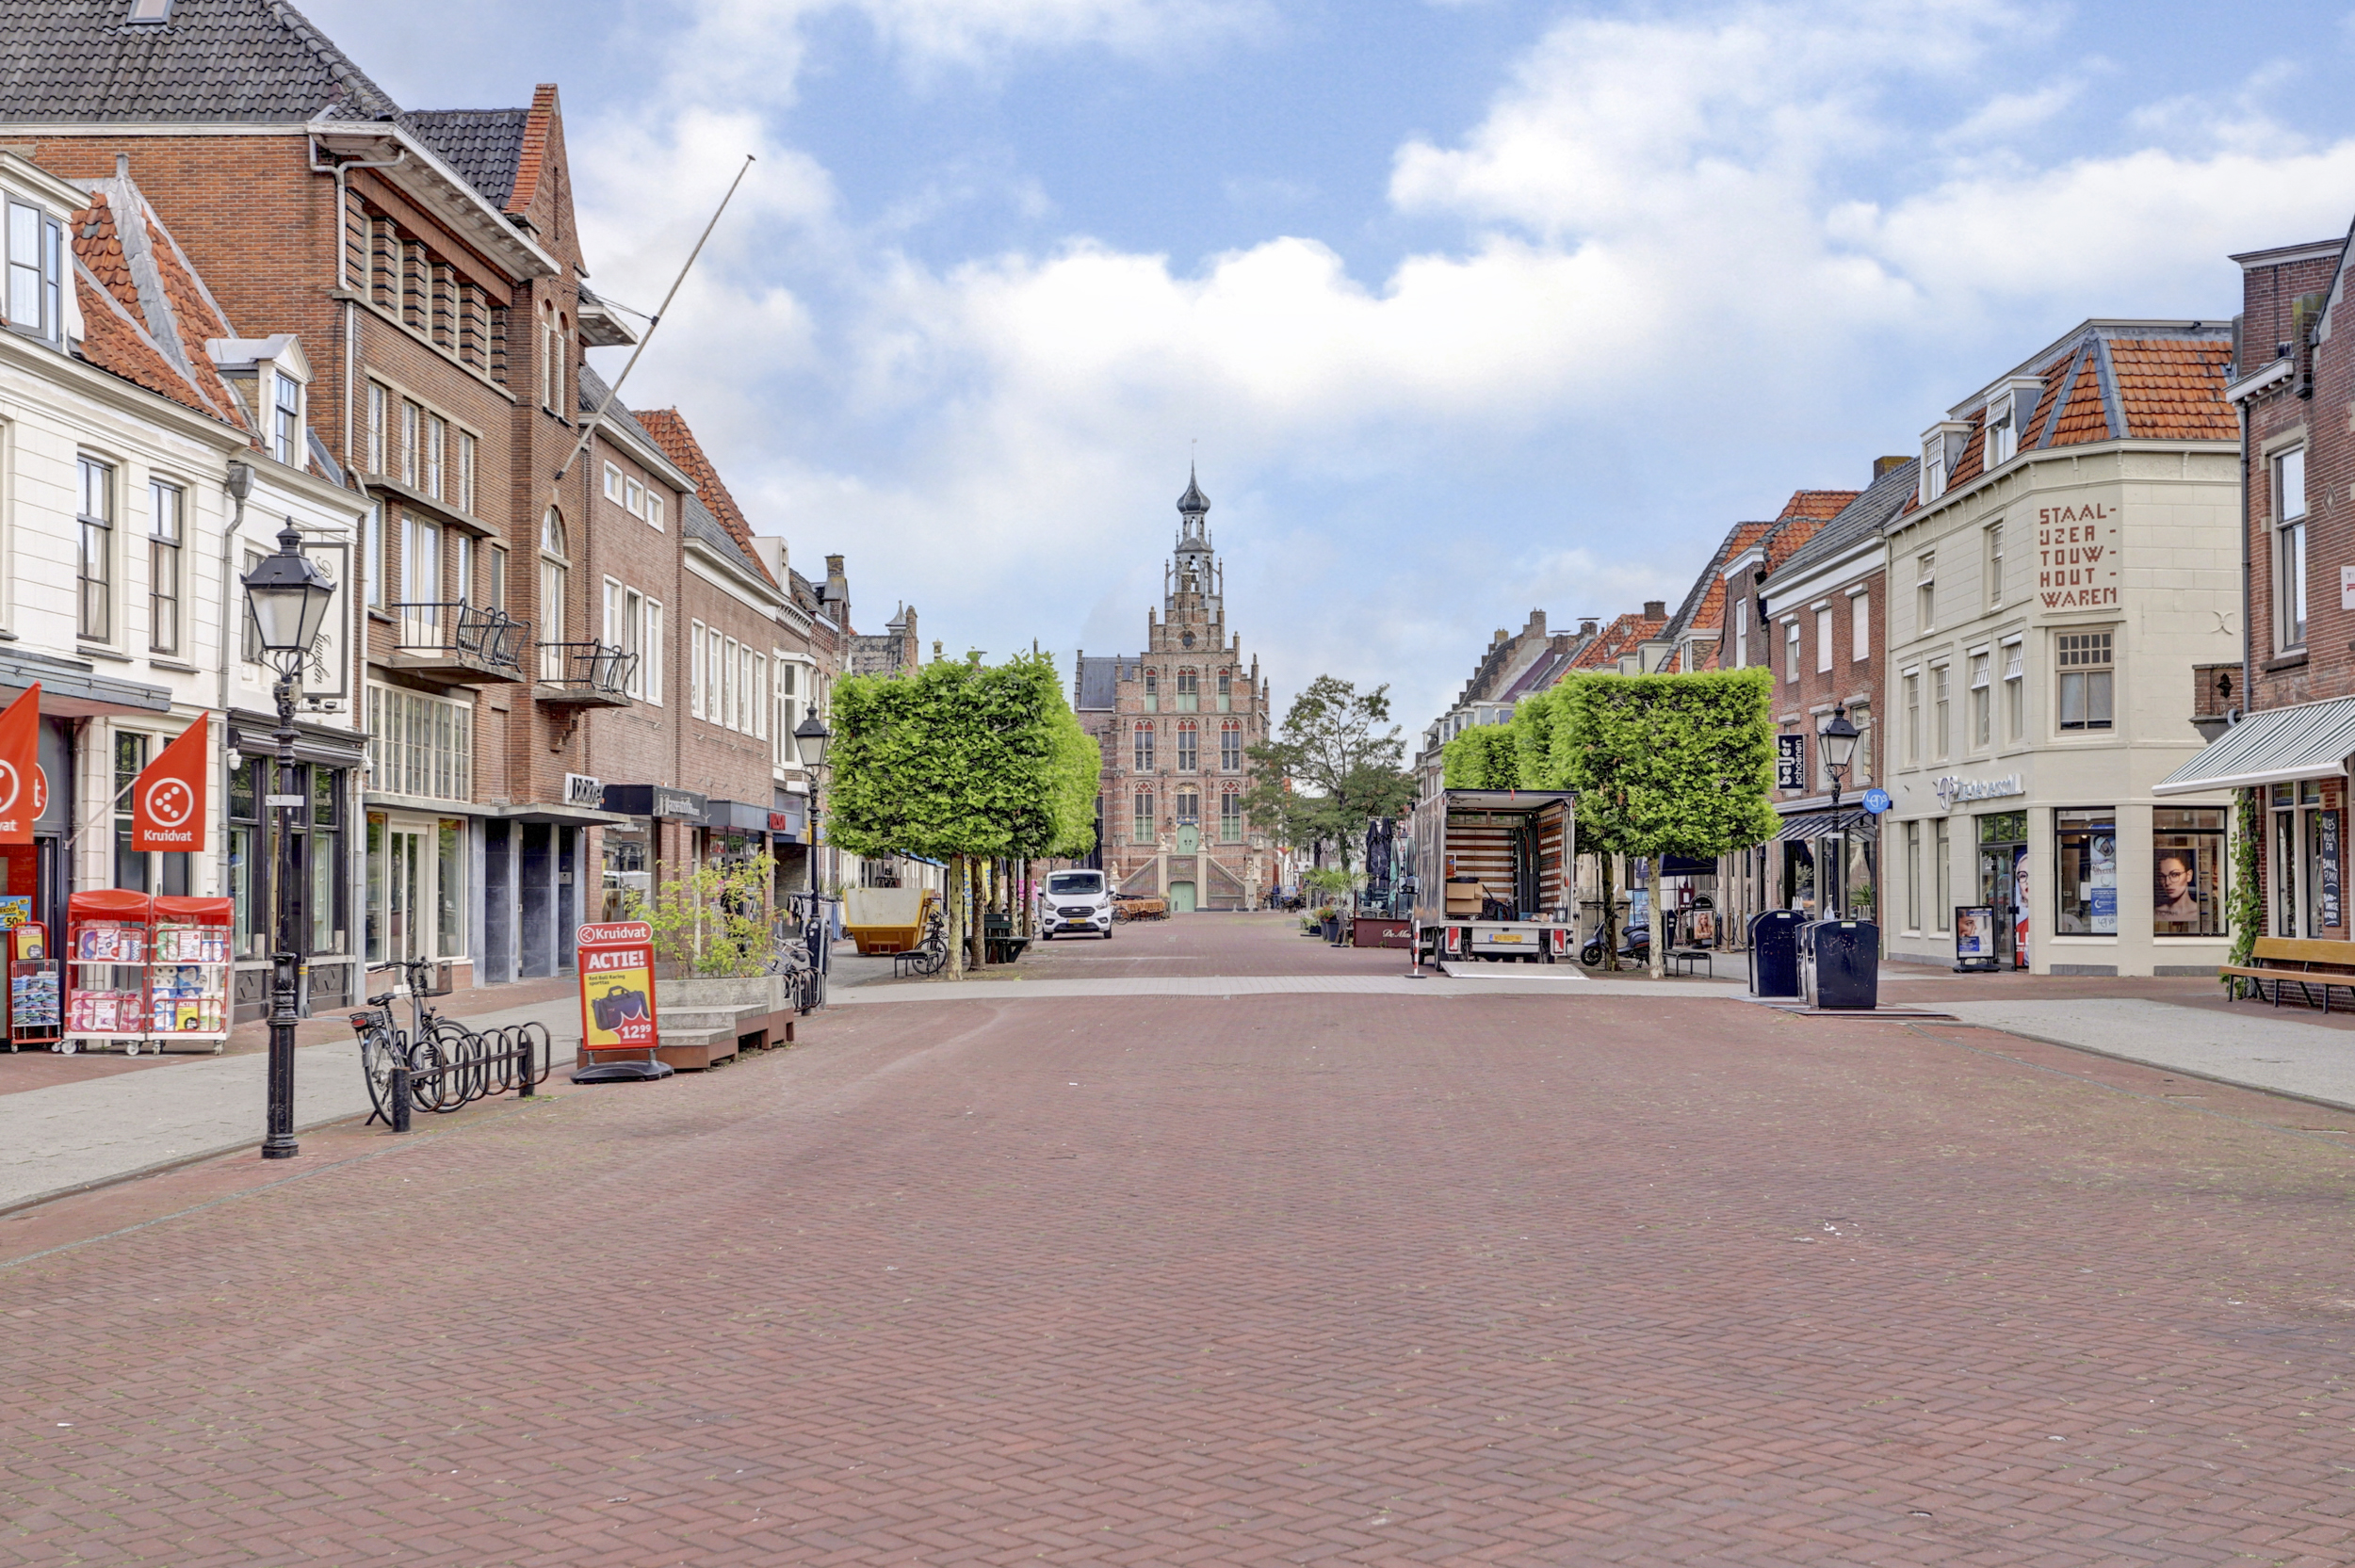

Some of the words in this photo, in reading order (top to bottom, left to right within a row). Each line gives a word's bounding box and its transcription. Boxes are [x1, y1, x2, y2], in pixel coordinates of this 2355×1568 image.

[2040, 587, 2117, 608] WAREN
[1778, 739, 1795, 785] beijer
[1795, 739, 1803, 785] schoenen
[143, 829, 193, 843] Kruidvat
[595, 926, 647, 940] Kruidvat
[588, 949, 645, 969] ACTIE!
